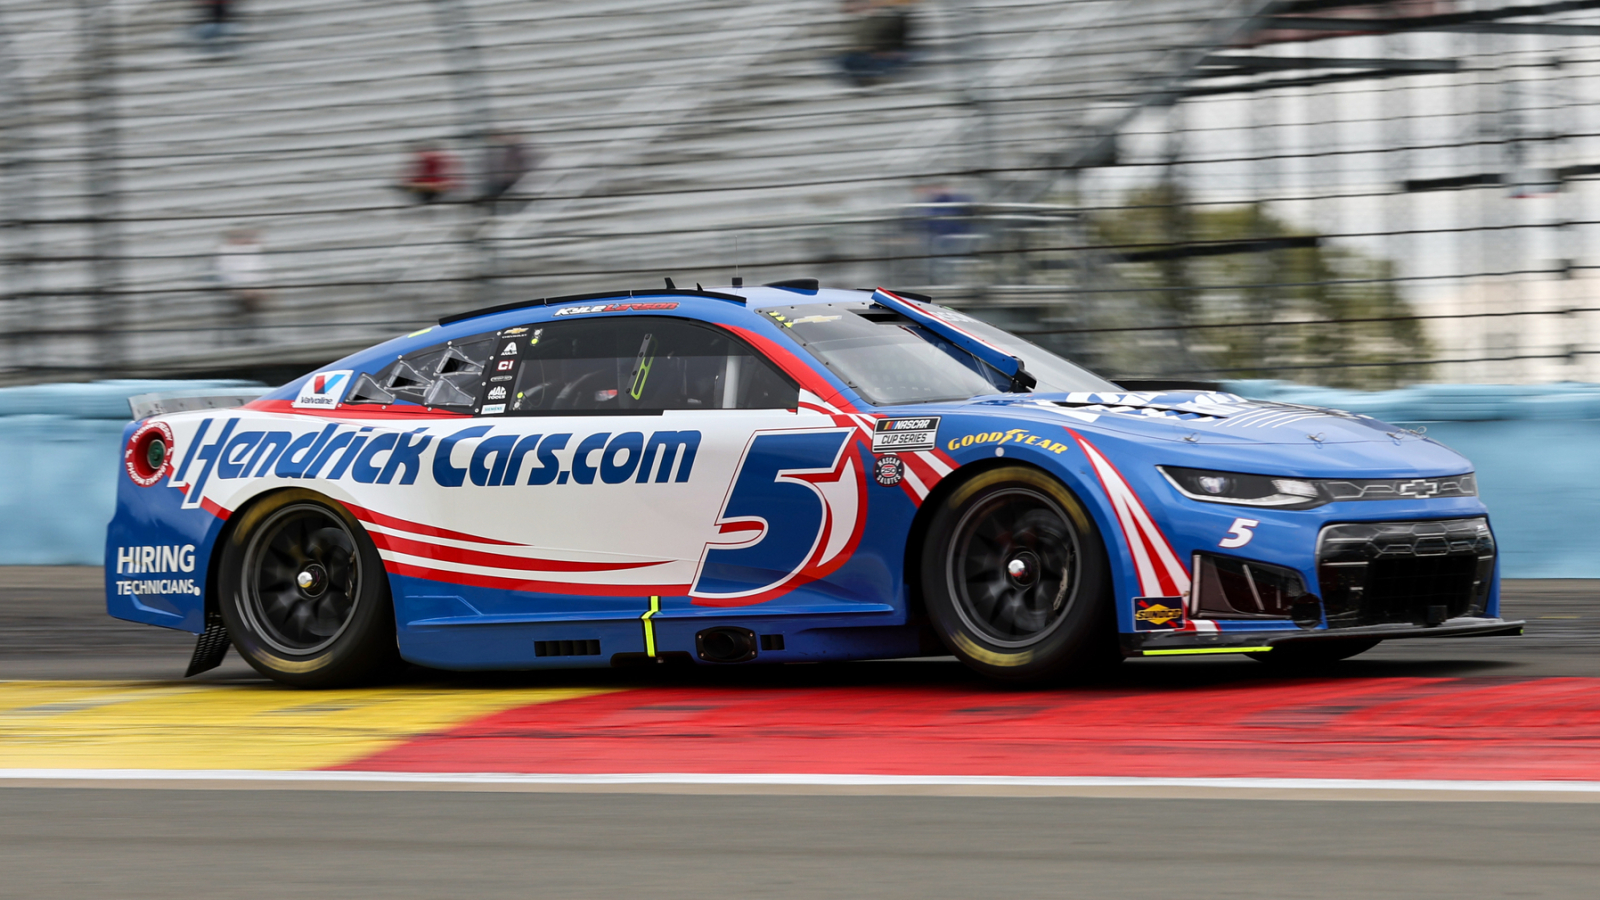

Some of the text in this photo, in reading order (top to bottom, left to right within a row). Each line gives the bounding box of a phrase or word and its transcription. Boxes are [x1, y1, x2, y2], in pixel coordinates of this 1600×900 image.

[498, 361, 514, 371] CI
[300, 397, 334, 405] Valvoline
[894, 419, 931, 430] NASCAR
[881, 432, 928, 445] CUP SERIES
[947, 428, 1068, 454] GOODYEAR
[877, 456, 901, 467] NASCAR
[688, 427, 858, 600] 5
[1218, 517, 1260, 549] 5
[116, 544, 195, 574] HIRING
[1135, 608, 1182, 620] SUNOCO
